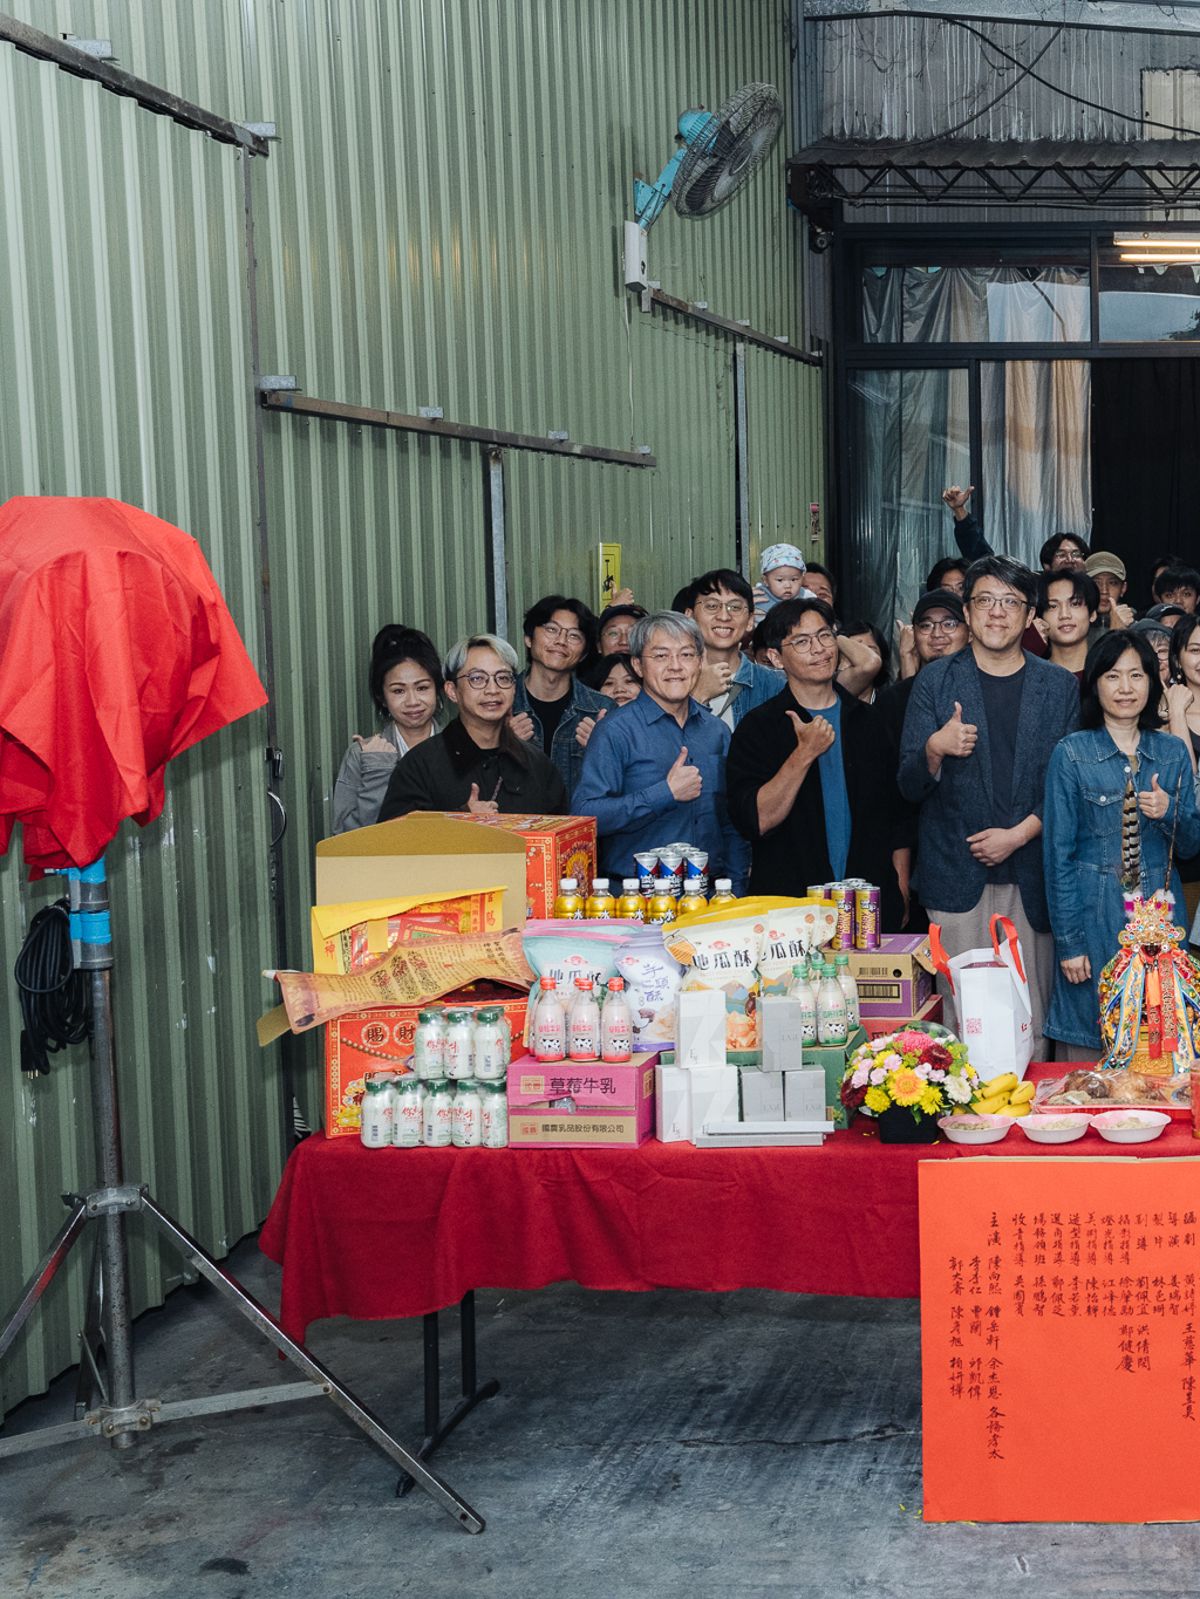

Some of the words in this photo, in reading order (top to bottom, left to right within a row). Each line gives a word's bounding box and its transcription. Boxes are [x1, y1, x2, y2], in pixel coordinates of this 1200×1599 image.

[550, 1077, 616, 1095] 草莓牛乳
[988, 1211, 1001, 1247] 主演
[1168, 1211, 1180, 1247] 導演
[1183, 1211, 1197, 1246] 編劇
